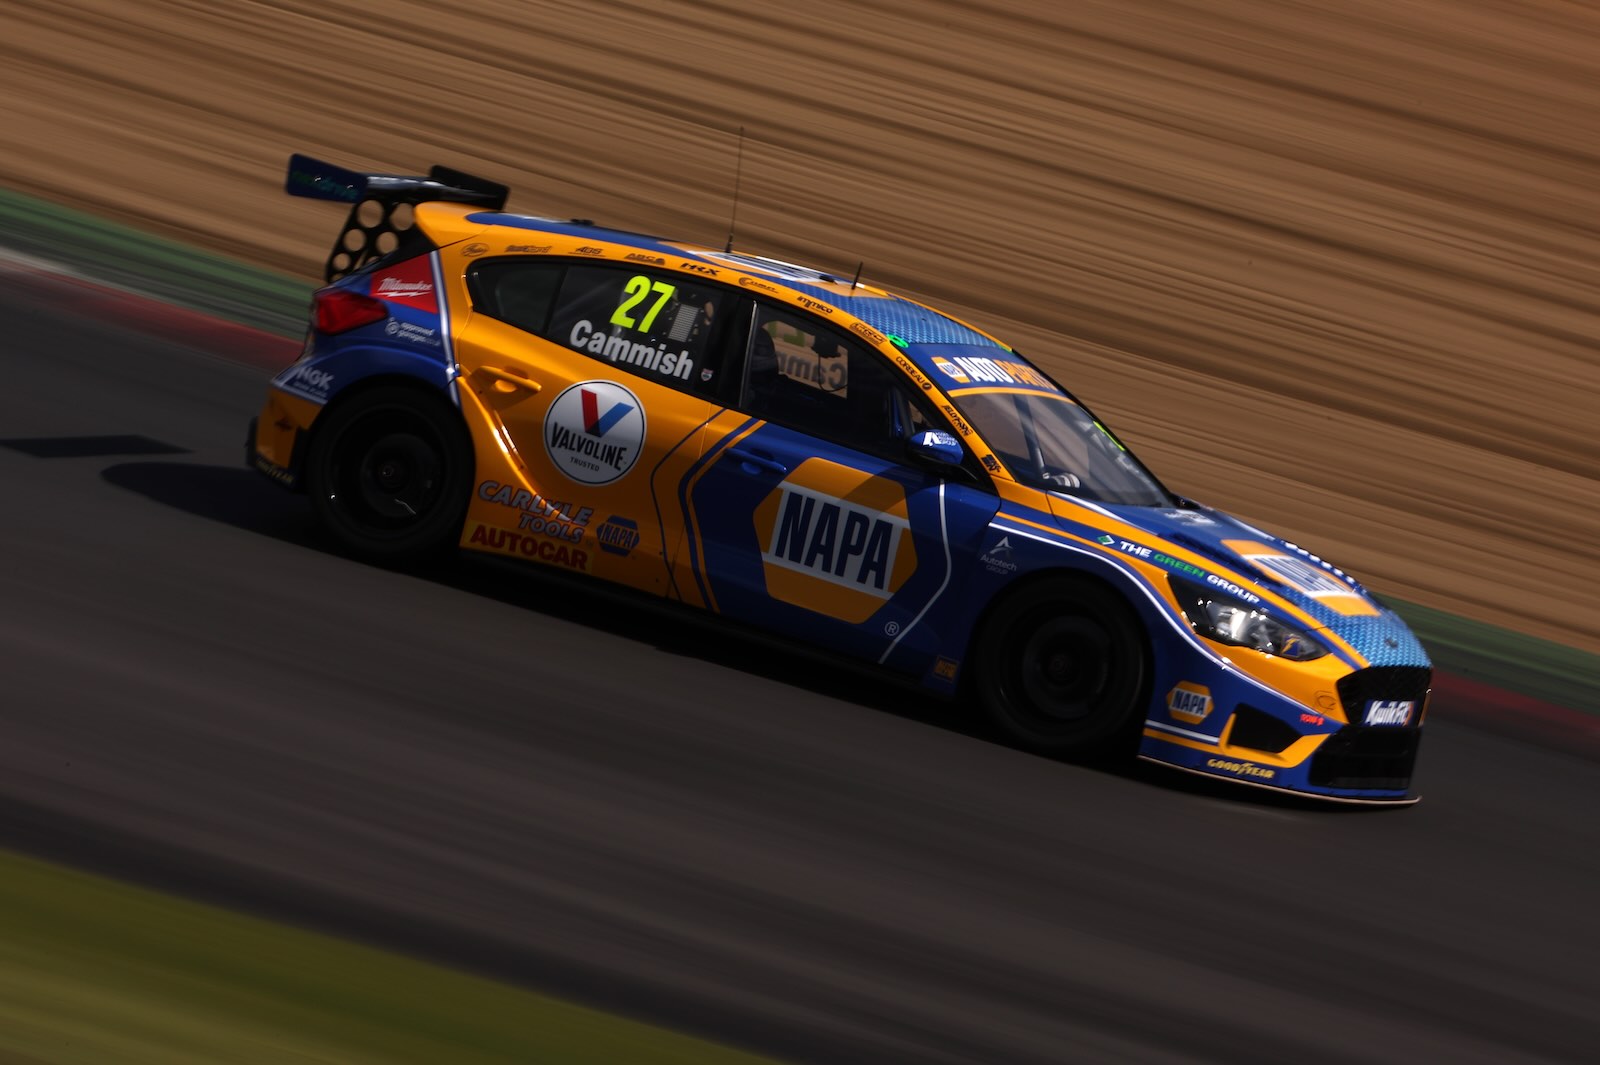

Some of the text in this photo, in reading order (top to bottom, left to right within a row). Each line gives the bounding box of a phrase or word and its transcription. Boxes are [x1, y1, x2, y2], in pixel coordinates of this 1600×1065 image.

[609, 275, 676, 334] 27
[569, 319, 694, 381] Cammish
[896, 356, 925, 384] CORBEAU
[953, 355, 1015, 384] AUTO
[551, 422, 628, 471] VALVOLINE
[569, 456, 600, 472] TRUSTED
[478, 480, 594, 526] CARLYLE
[518, 513, 585, 544] TOOLS
[600, 522, 635, 549] NAPA
[774, 491, 894, 591] NAPA
[469, 525, 588, 571] AUTOCAR
[1119, 540, 1153, 558] THE
[1153, 553, 1206, 579] GREEN
[1206, 574, 1260, 605] GROUP
[1171, 689, 1206, 716] NAPA
[1206, 758, 1276, 779] GOODYEAR
